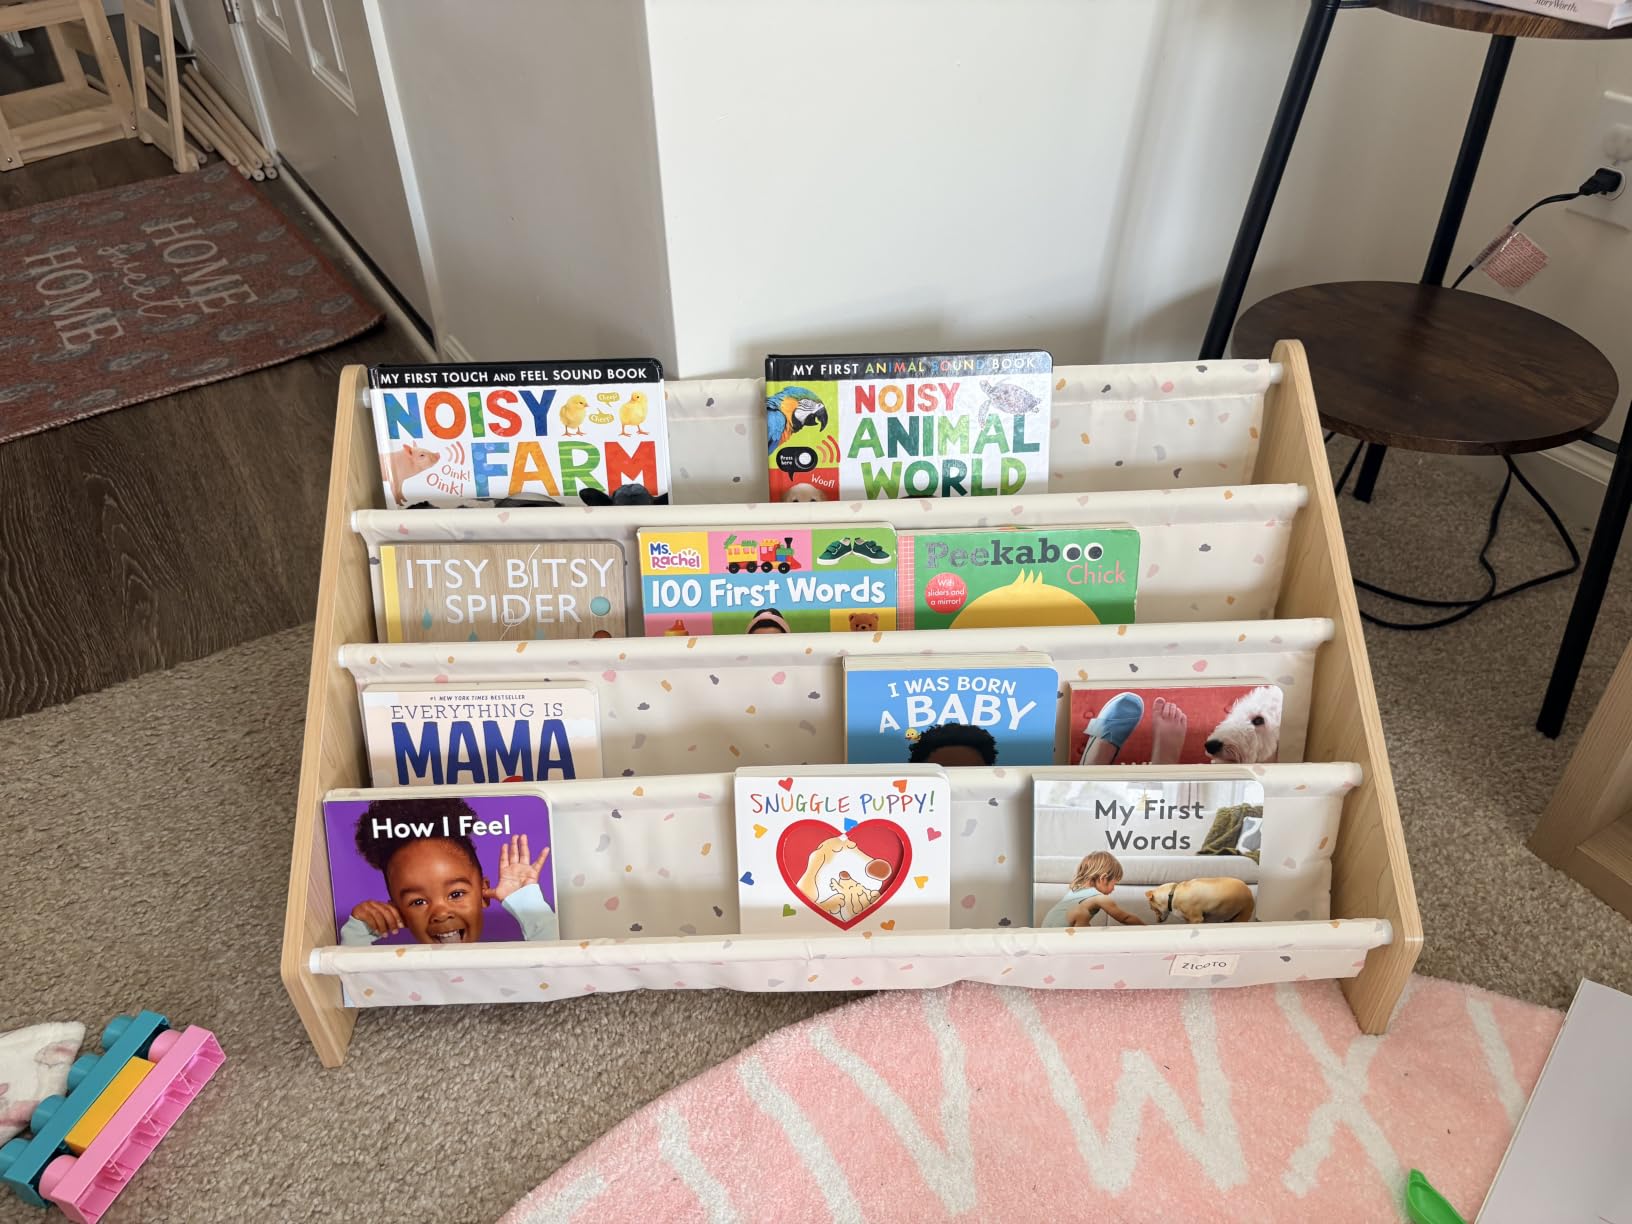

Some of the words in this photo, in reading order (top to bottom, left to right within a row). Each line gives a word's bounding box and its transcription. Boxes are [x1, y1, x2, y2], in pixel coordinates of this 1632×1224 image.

[145, 217, 258, 314] HOME
[24, 246, 125, 350] HOME
[380, 373, 400, 385] MY
[404, 372, 437, 384] FIRST
[442, 371, 488, 383] TOUCH
[493, 373, 516, 382] AND
[520, 370, 548, 381] FEEL
[553, 369, 602, 381] SOUND
[607, 368, 647, 379] BOOK
[793, 364, 813, 375] MY
[821, 363, 859, 375] FIRST
[865, 361, 925, 373] ANIMAL
[931, 359, 985, 372] SOUND
[992, 358, 1036, 370] BOOK
[855, 382, 960, 414] NOISY
[383, 389, 557, 439] NOISY
[847, 414, 1040, 458] ANIMAL
[441, 465, 470, 482] Oink!
[471, 441, 658, 498] FARM
[860, 457, 1027, 500] WORLD
[427, 473, 463, 497] Oink!
[650, 543, 671, 556] Ms.
[652, 553, 700, 568] Rachel
[925, 538, 1104, 568] Peekaboo
[406, 560, 489, 589] ITSY
[507, 558, 615, 588] BITSY
[1066, 561, 1126, 585] Chick
[652, 579, 702, 607] 100
[710, 577, 780, 607] First
[786, 575, 886, 604] Words
[928, 588, 949, 597] sliders
[950, 587, 965, 596] and
[446, 594, 582, 624] SPIDER
[888, 683, 900, 698] I
[904, 677, 949, 694] WAS
[957, 676, 1017, 696] BORN
[391, 703, 534, 719] EVERYTHING
[545, 703, 563, 716] IS
[879, 710, 901, 734] A
[906, 693, 1037, 731] BABY
[391, 719, 576, 785] MAMA
[750, 793, 850, 814] SNUGGLE
[859, 790, 935, 814] PUPPY!
[1095, 799, 1135, 826] My
[1144, 799, 1205, 820] First
[371, 818, 434, 839] How
[443, 816, 450, 836] I
[459, 814, 511, 837] Feel
[1105, 830, 1191, 850] Words
